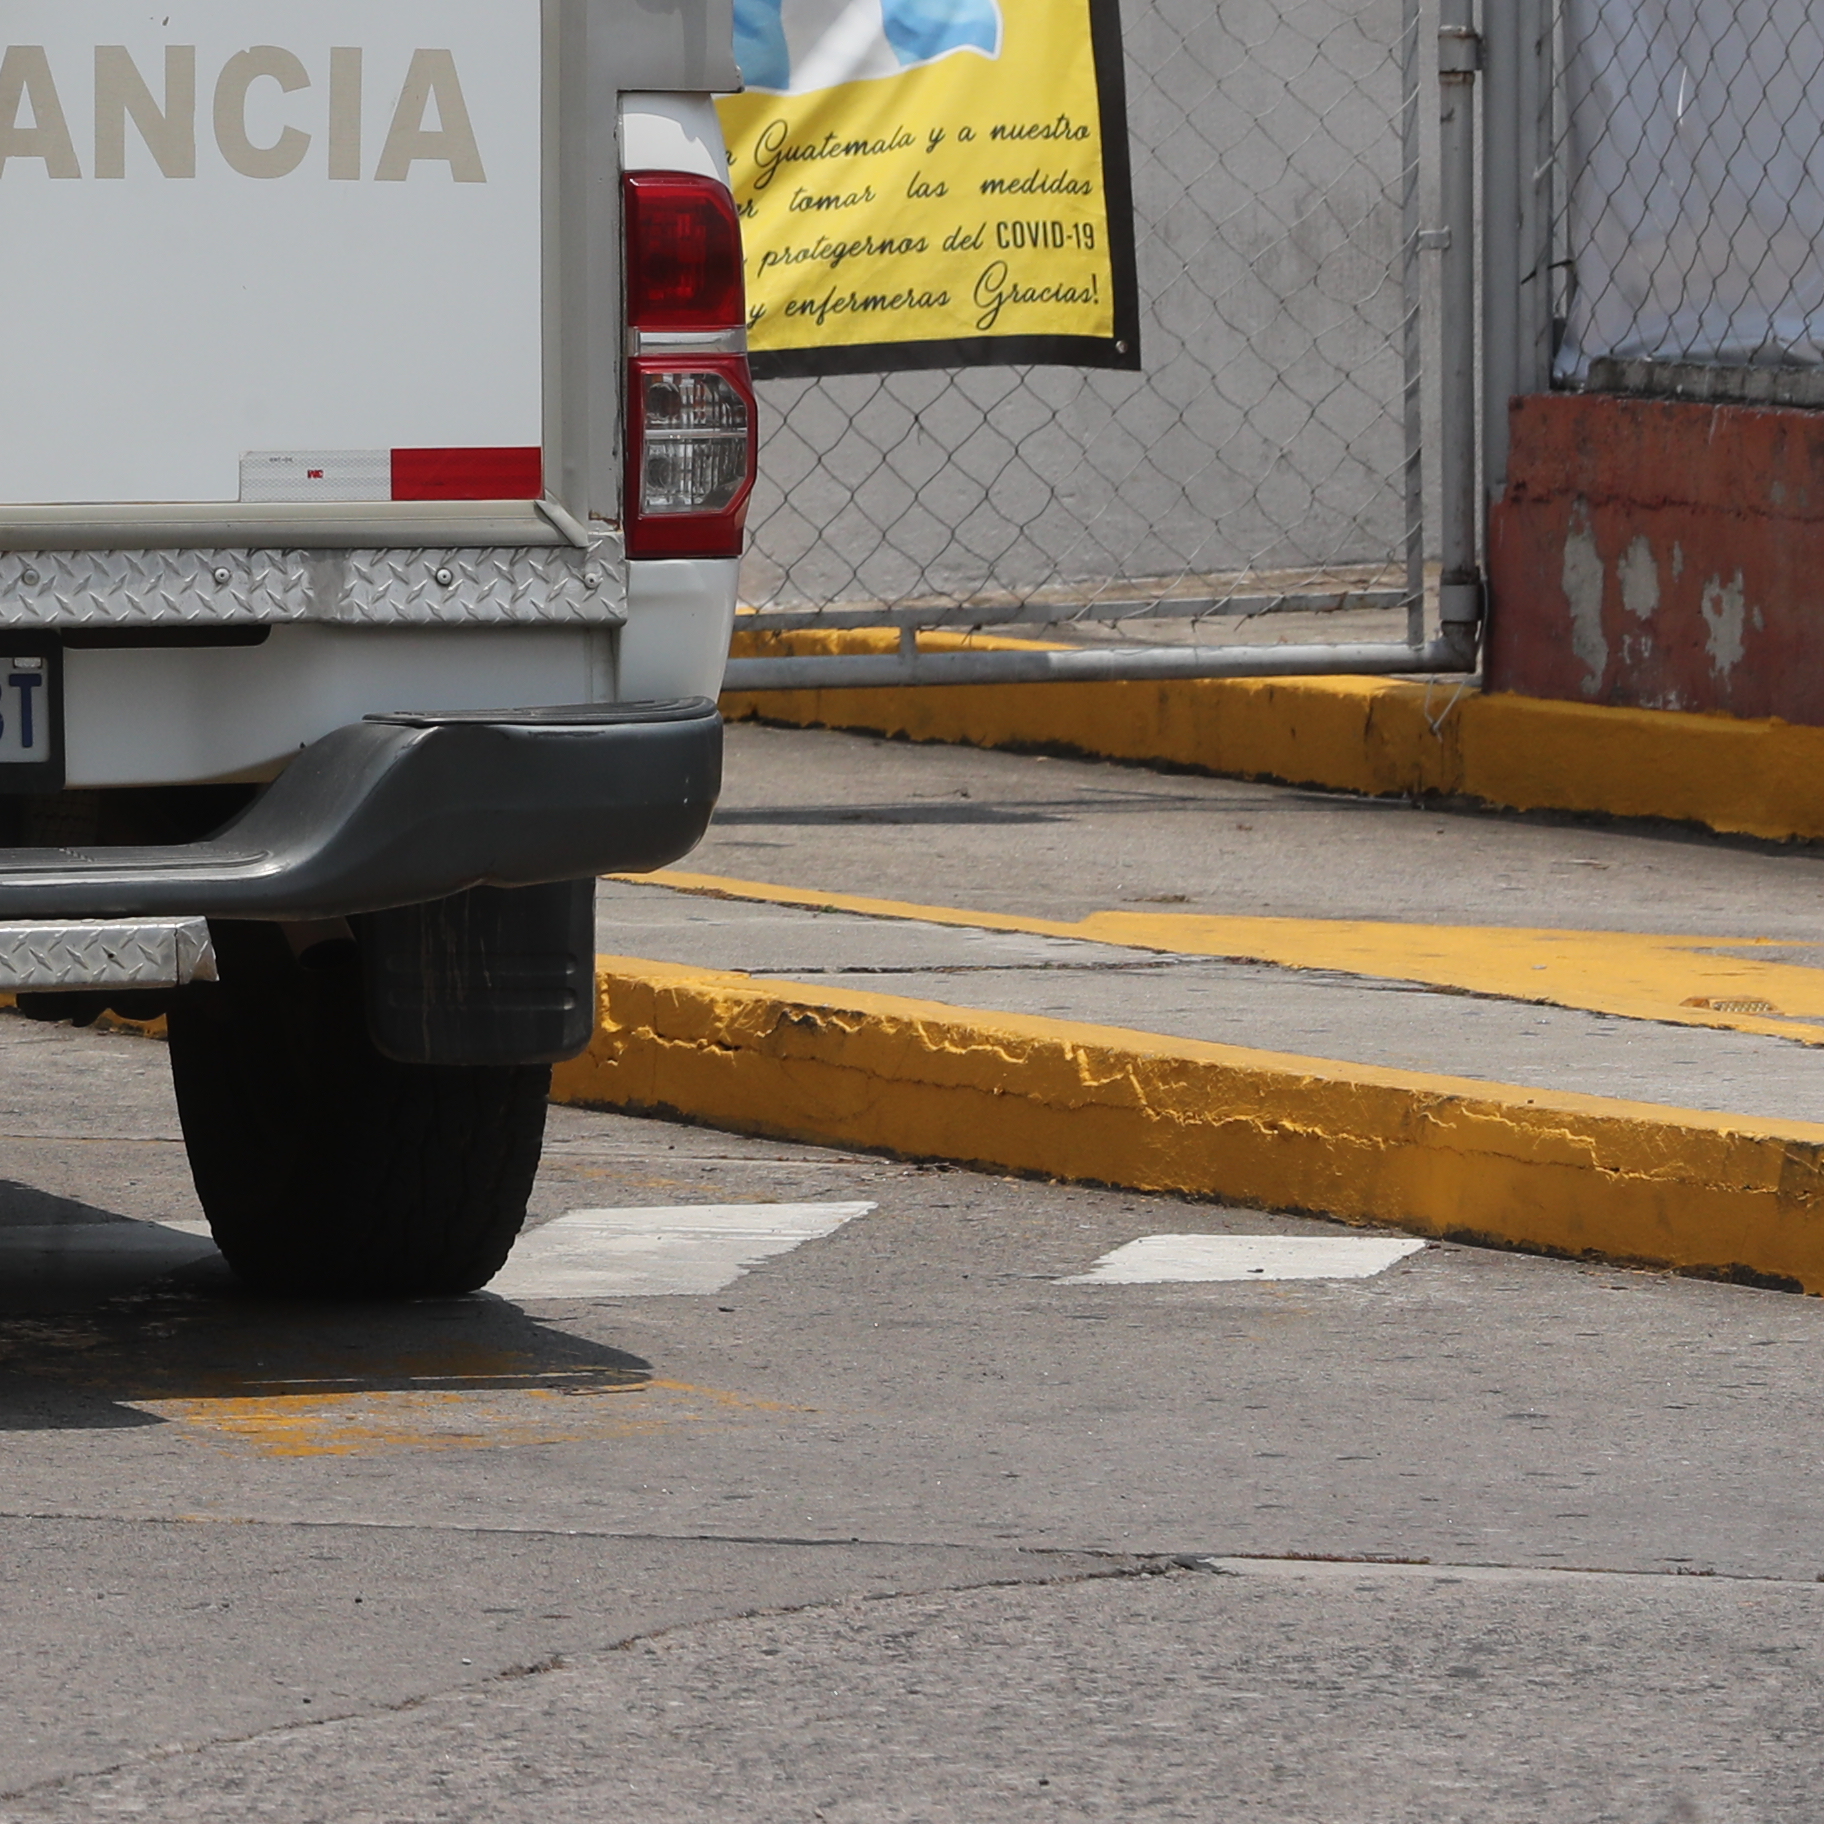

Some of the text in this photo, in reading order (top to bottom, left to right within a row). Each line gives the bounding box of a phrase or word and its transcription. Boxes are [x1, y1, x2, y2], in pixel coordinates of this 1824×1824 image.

[753, 118, 916, 190] Guatemala
[926, 125, 947, 154] y
[957, 125, 976, 142] a
[989, 112, 1092, 142] nuestro
[789, 185, 877, 213] tomar
[906, 170, 950, 198] las
[979, 168, 1093, 196] medidas
[757, 234, 930, 278] protegernos
[942, 221, 987, 252] del
[995, 220, 1096, 250] COVID-19
[784, 285, 951, 326] enfermeras
[973, 260, 1100, 331] Gracias!
[307, 469, 324, 479] 3M
